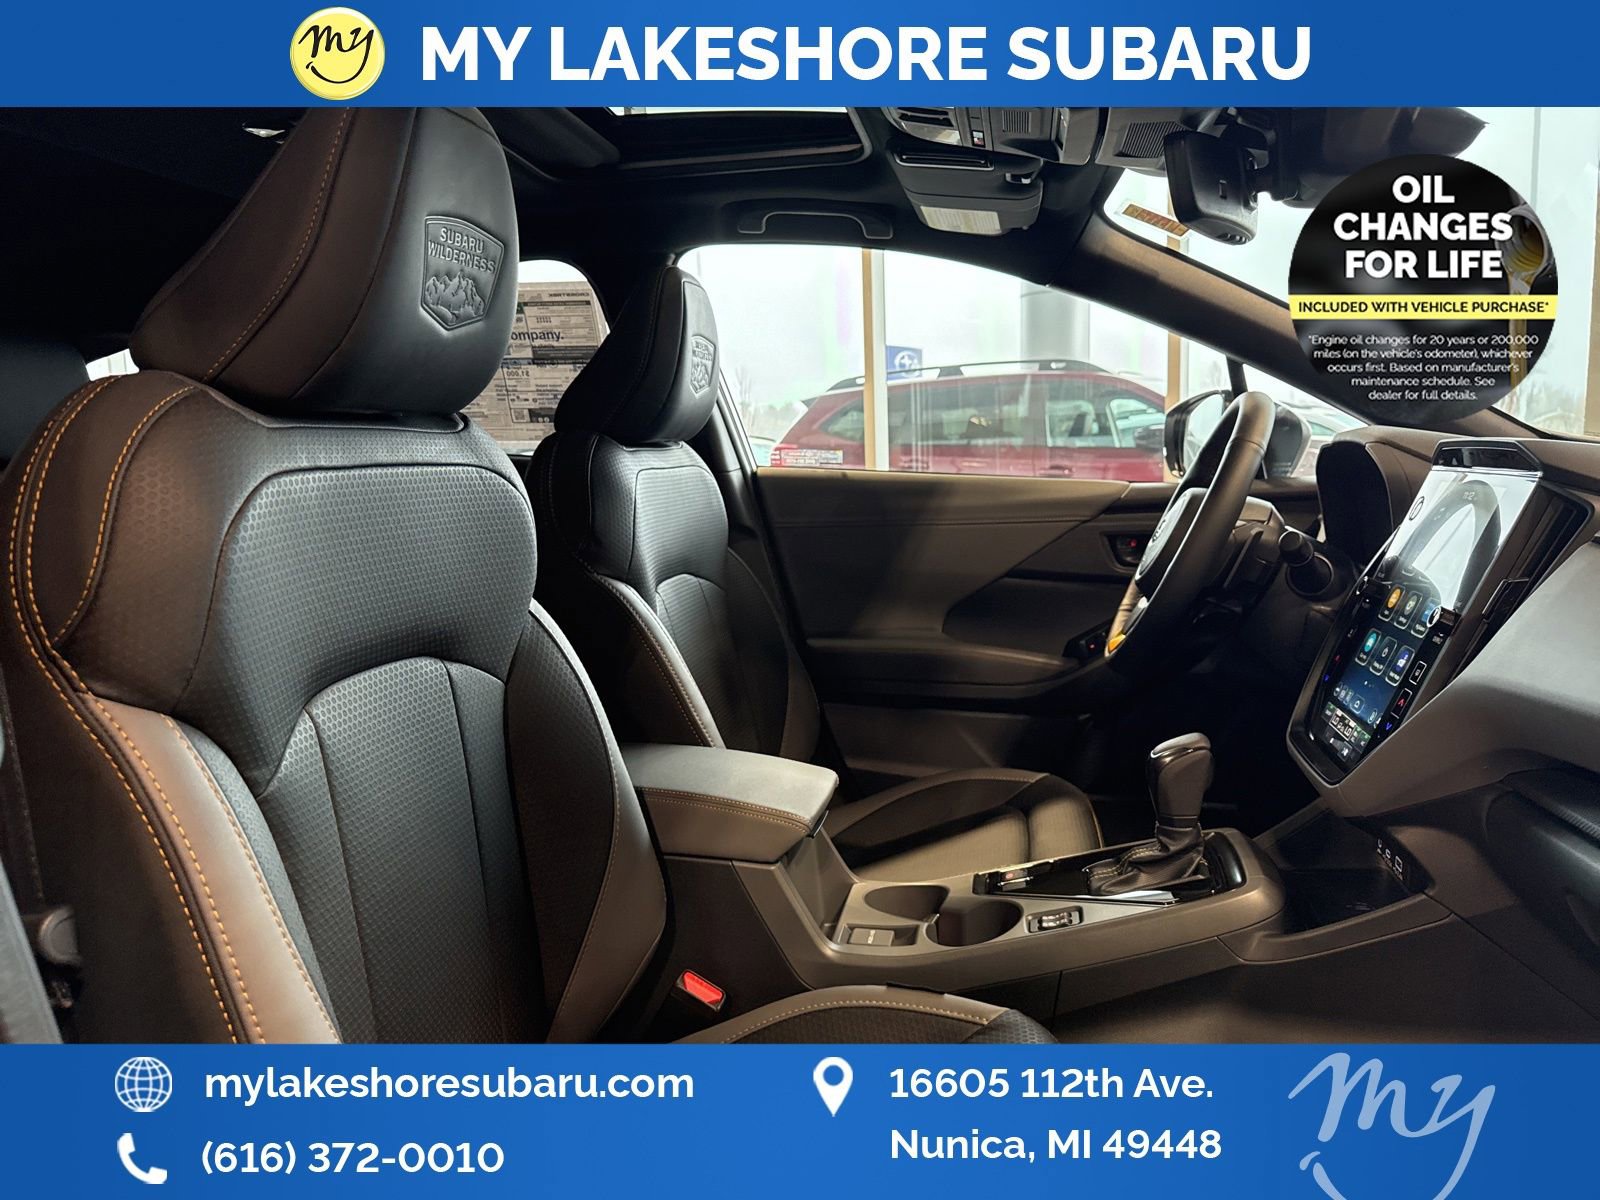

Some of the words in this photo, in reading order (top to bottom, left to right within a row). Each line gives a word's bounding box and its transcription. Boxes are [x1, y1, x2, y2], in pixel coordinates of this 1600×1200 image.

[439, 227, 485, 253] SUBARU
[427, 241, 496, 273] WILDERNESS
[511, 331, 564, 342] ompany.
